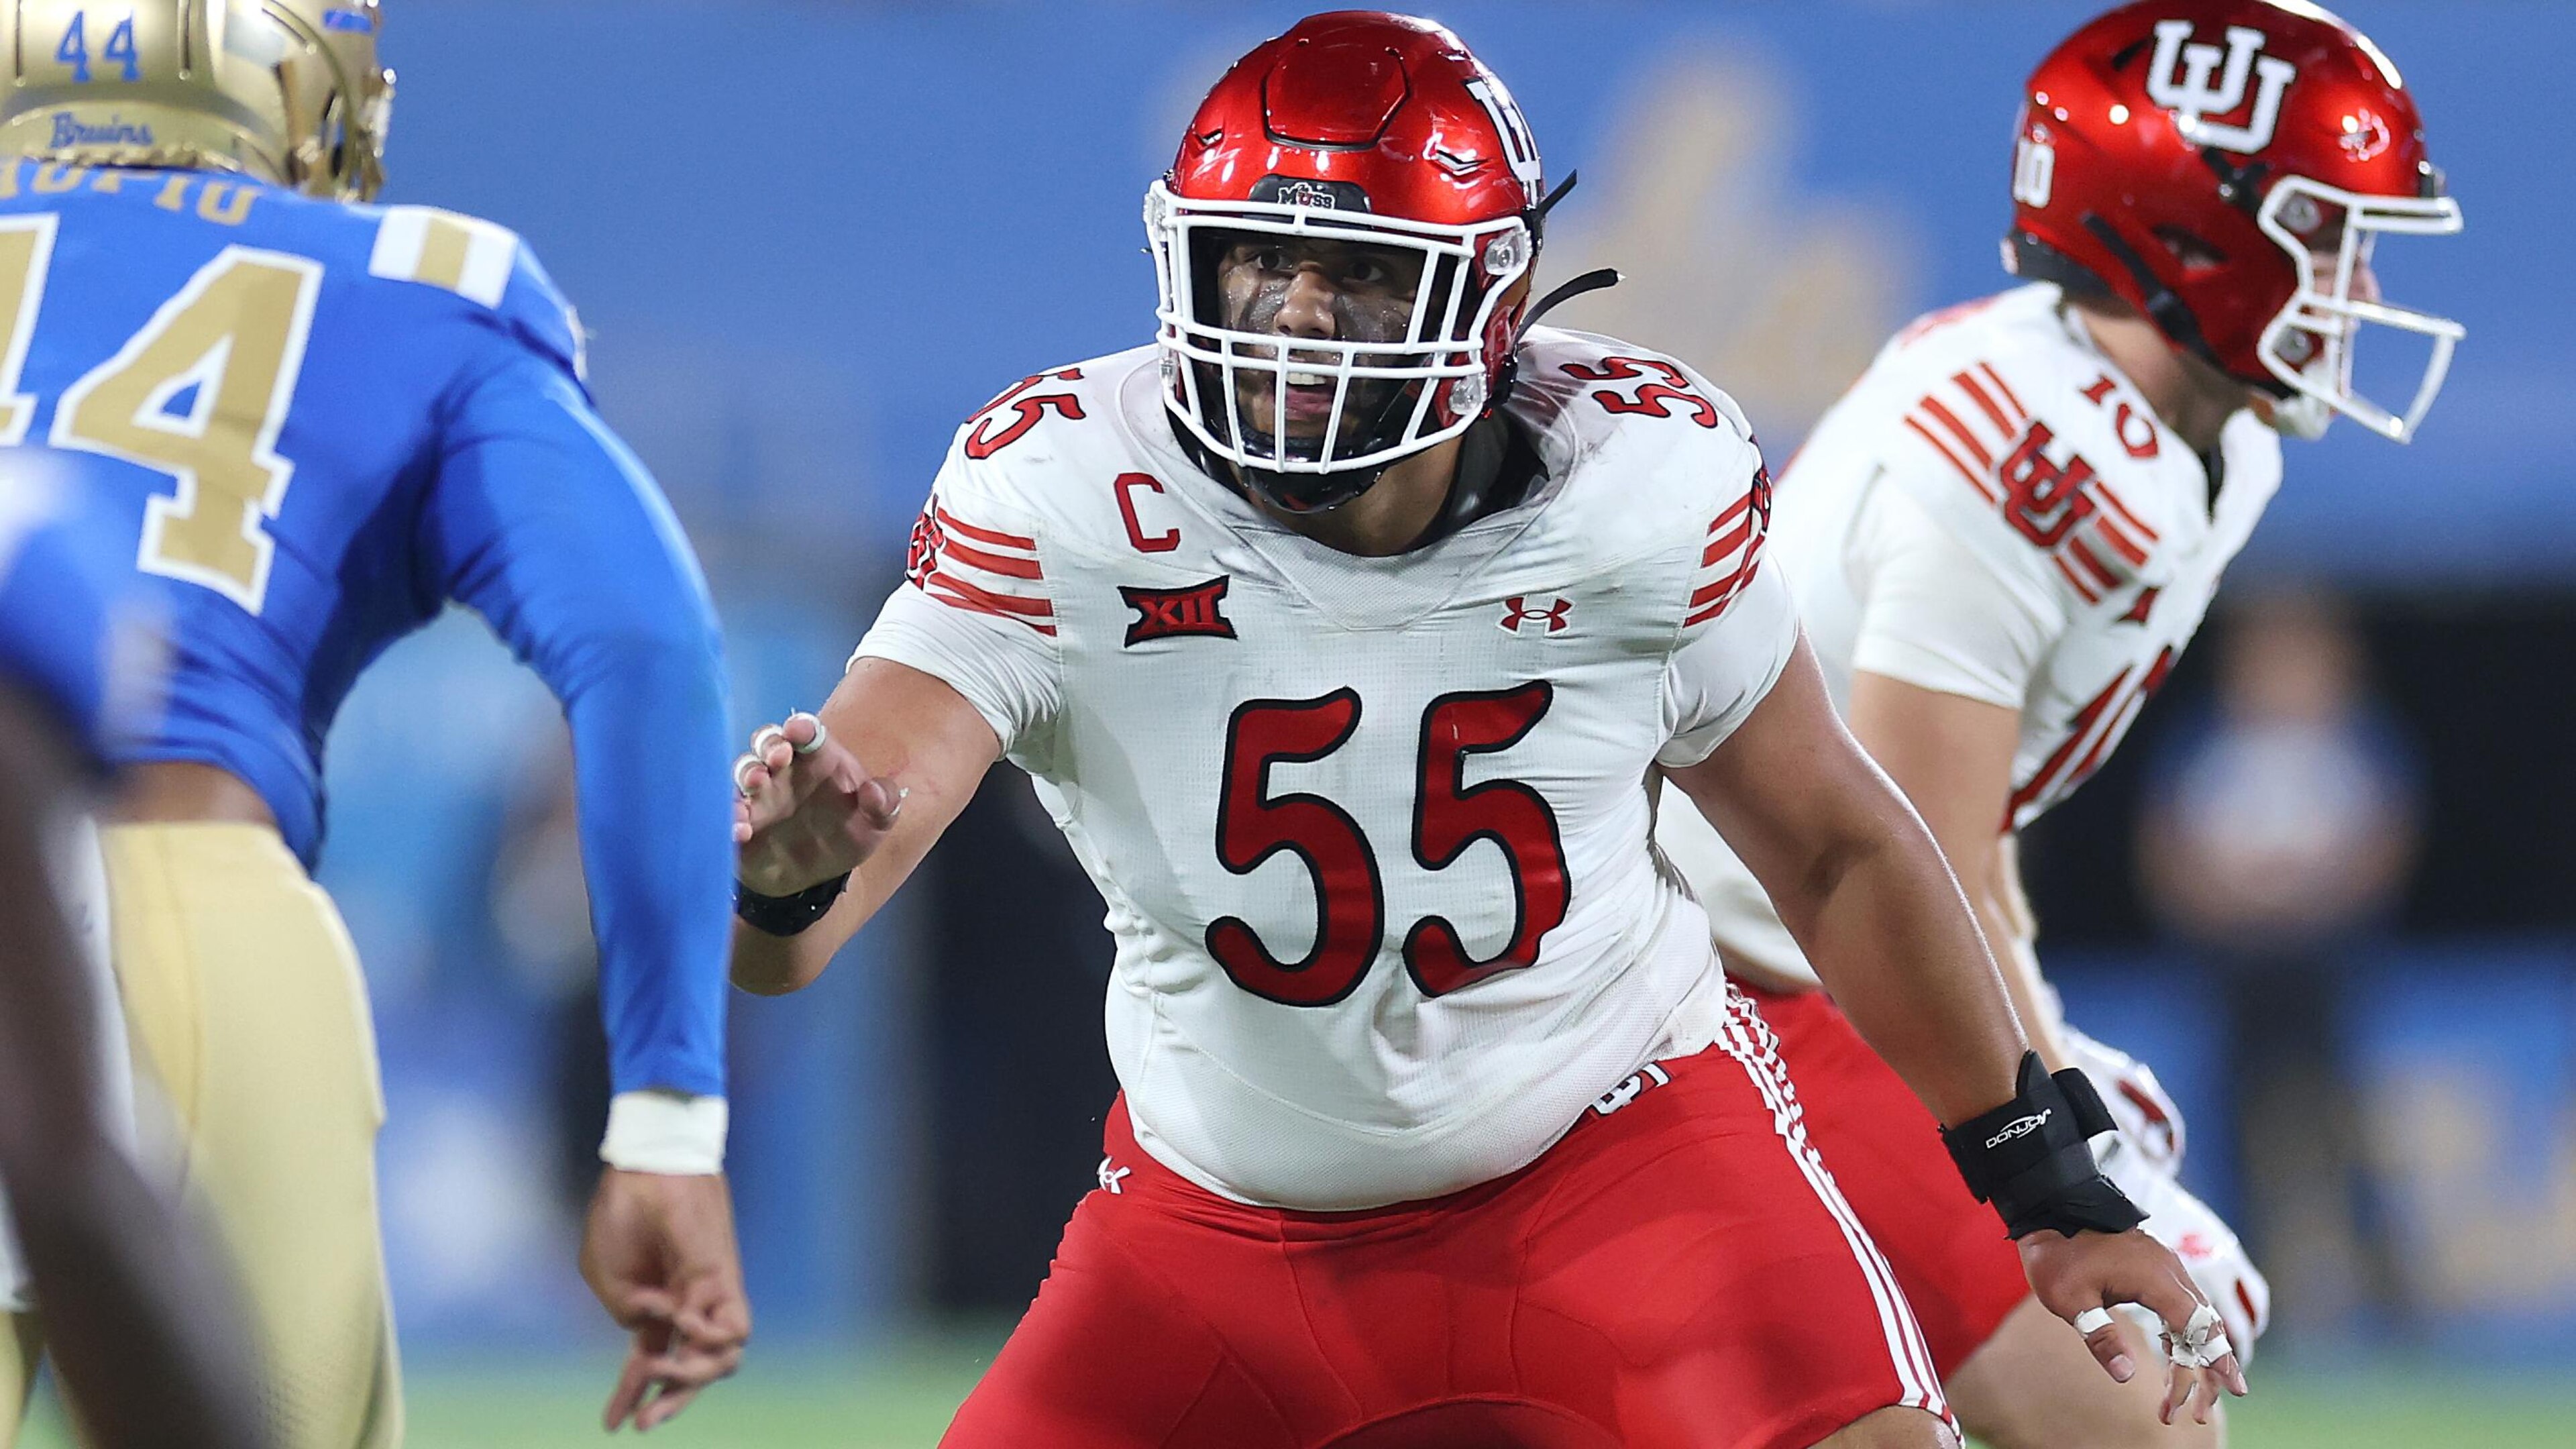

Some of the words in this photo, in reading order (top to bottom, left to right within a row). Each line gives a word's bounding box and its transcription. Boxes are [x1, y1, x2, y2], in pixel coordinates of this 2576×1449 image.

[56, 9, 142, 83] 44
[51, 111, 154, 149] Bruins
[1558, 356, 1719, 429] 55
[2080, 376, 2158, 458] 10
[1114, 472, 1181, 553] C
[1129, 583, 1229, 638] XII
[1205, 679, 1571, 1008] 55
[1986, 1109, 2048, 1148] DONJOY
